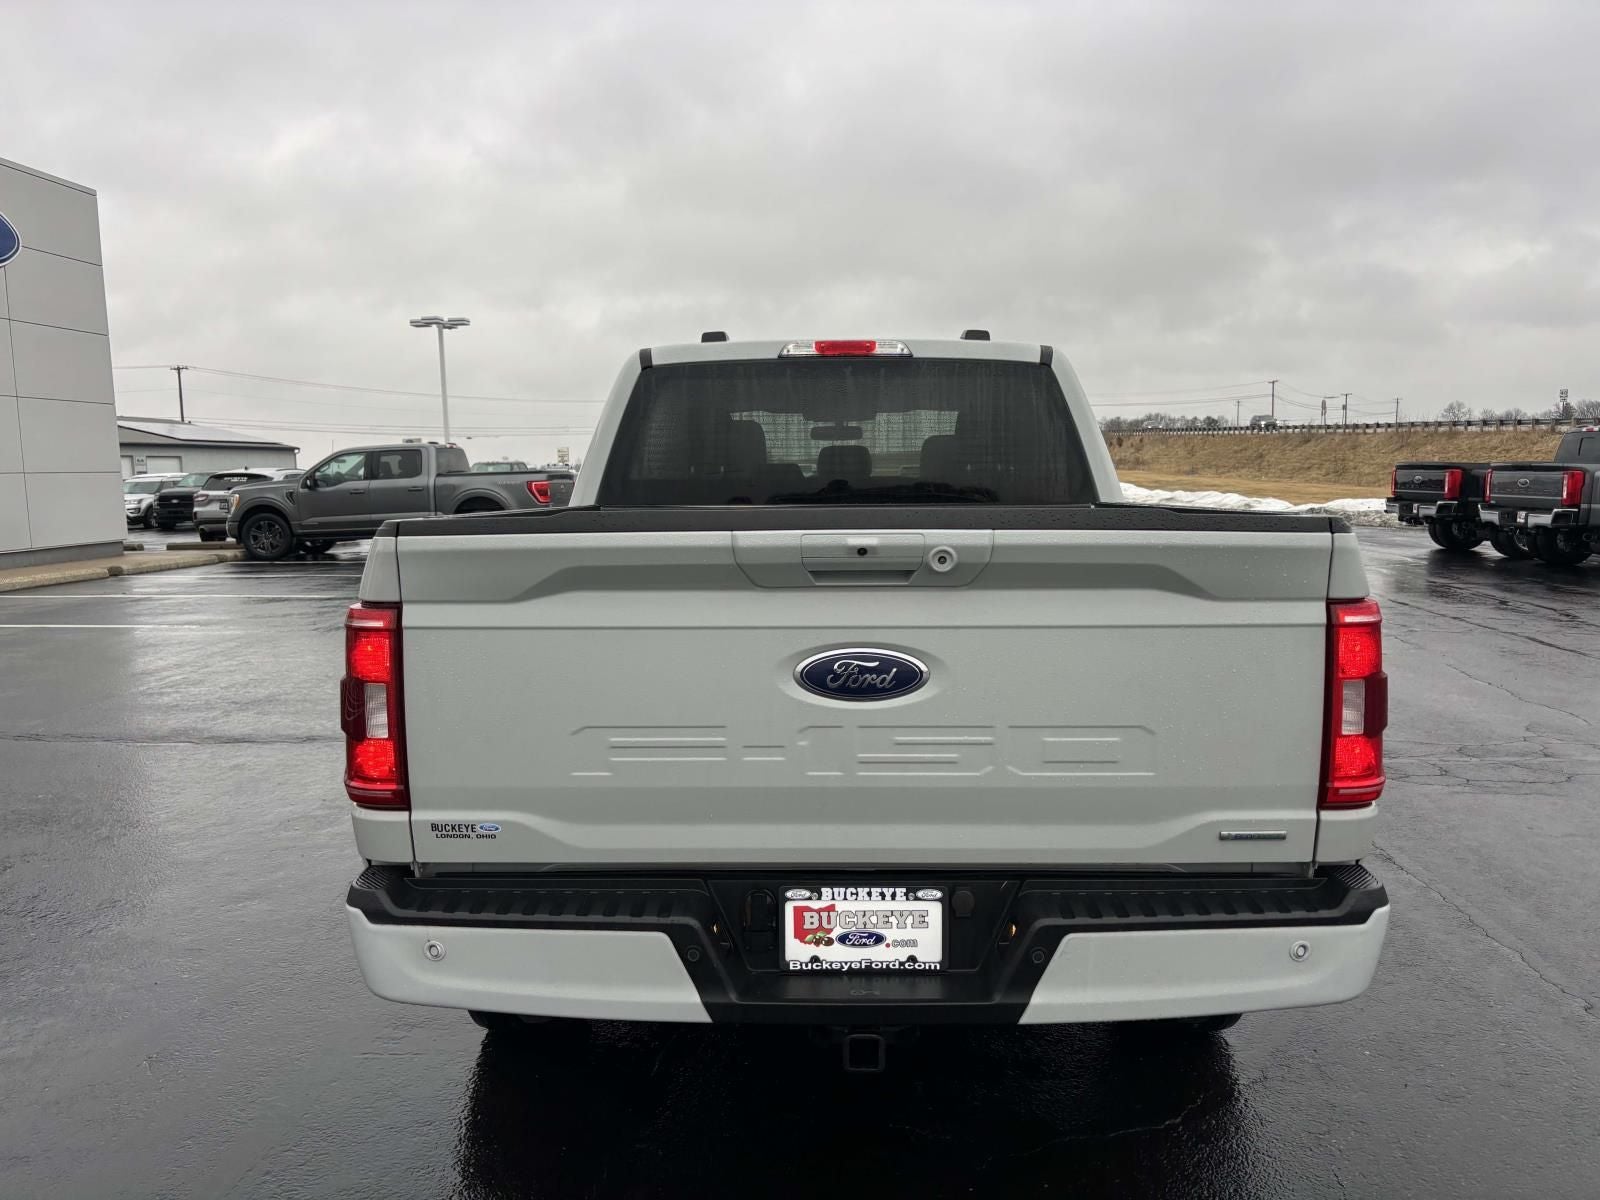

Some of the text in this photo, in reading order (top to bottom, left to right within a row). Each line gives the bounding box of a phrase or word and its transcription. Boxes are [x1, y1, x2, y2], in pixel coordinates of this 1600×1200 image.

[826, 659, 898, 689] Ford
[568, 724, 1156, 777] F-150
[430, 823, 477, 833] BUCKEYE
[821, 887, 907, 901] BUCKEYE
[803, 910, 929, 929] BUCKEYE
[846, 932, 876, 946] Ford
[789, 960, 941, 971] BuckeyeFord.com
